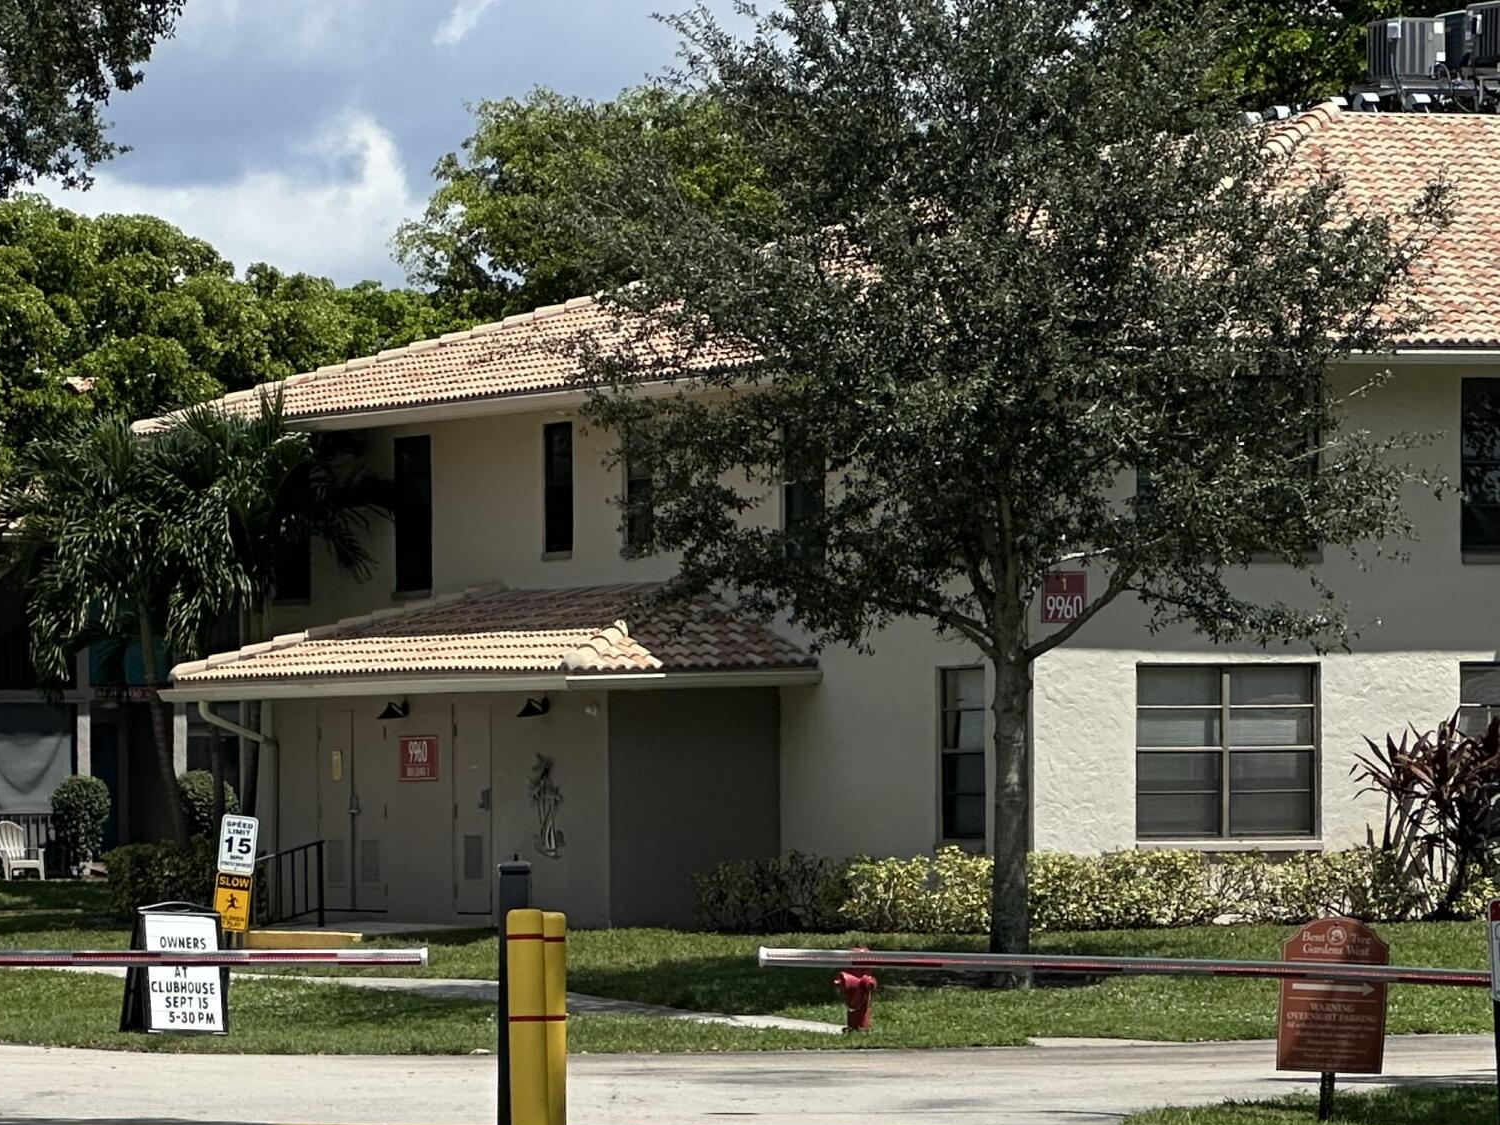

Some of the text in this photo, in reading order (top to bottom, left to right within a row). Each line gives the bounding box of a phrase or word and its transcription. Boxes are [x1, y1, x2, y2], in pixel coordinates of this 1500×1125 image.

[1061, 578, 1067, 590] 1
[1046, 595, 1083, 619] 9960
[408, 741, 428, 762] 9960
[227, 820, 254, 830] SPEED
[228, 828, 251, 836] LIMIT
[225, 836, 252, 855] 15
[219, 876, 249, 889] SLOW
[160, 936, 206, 950] OWNERS
[1302, 931, 1372, 944] Bent Tree
[1302, 943, 1370, 956] Gardens West
[175, 966, 188, 979] AT
[151, 981, 216, 995] CLUBHOUSE
[165, 996, 209, 1009] SEPT 15
[169, 1012, 216, 1024] 5-30 PM
